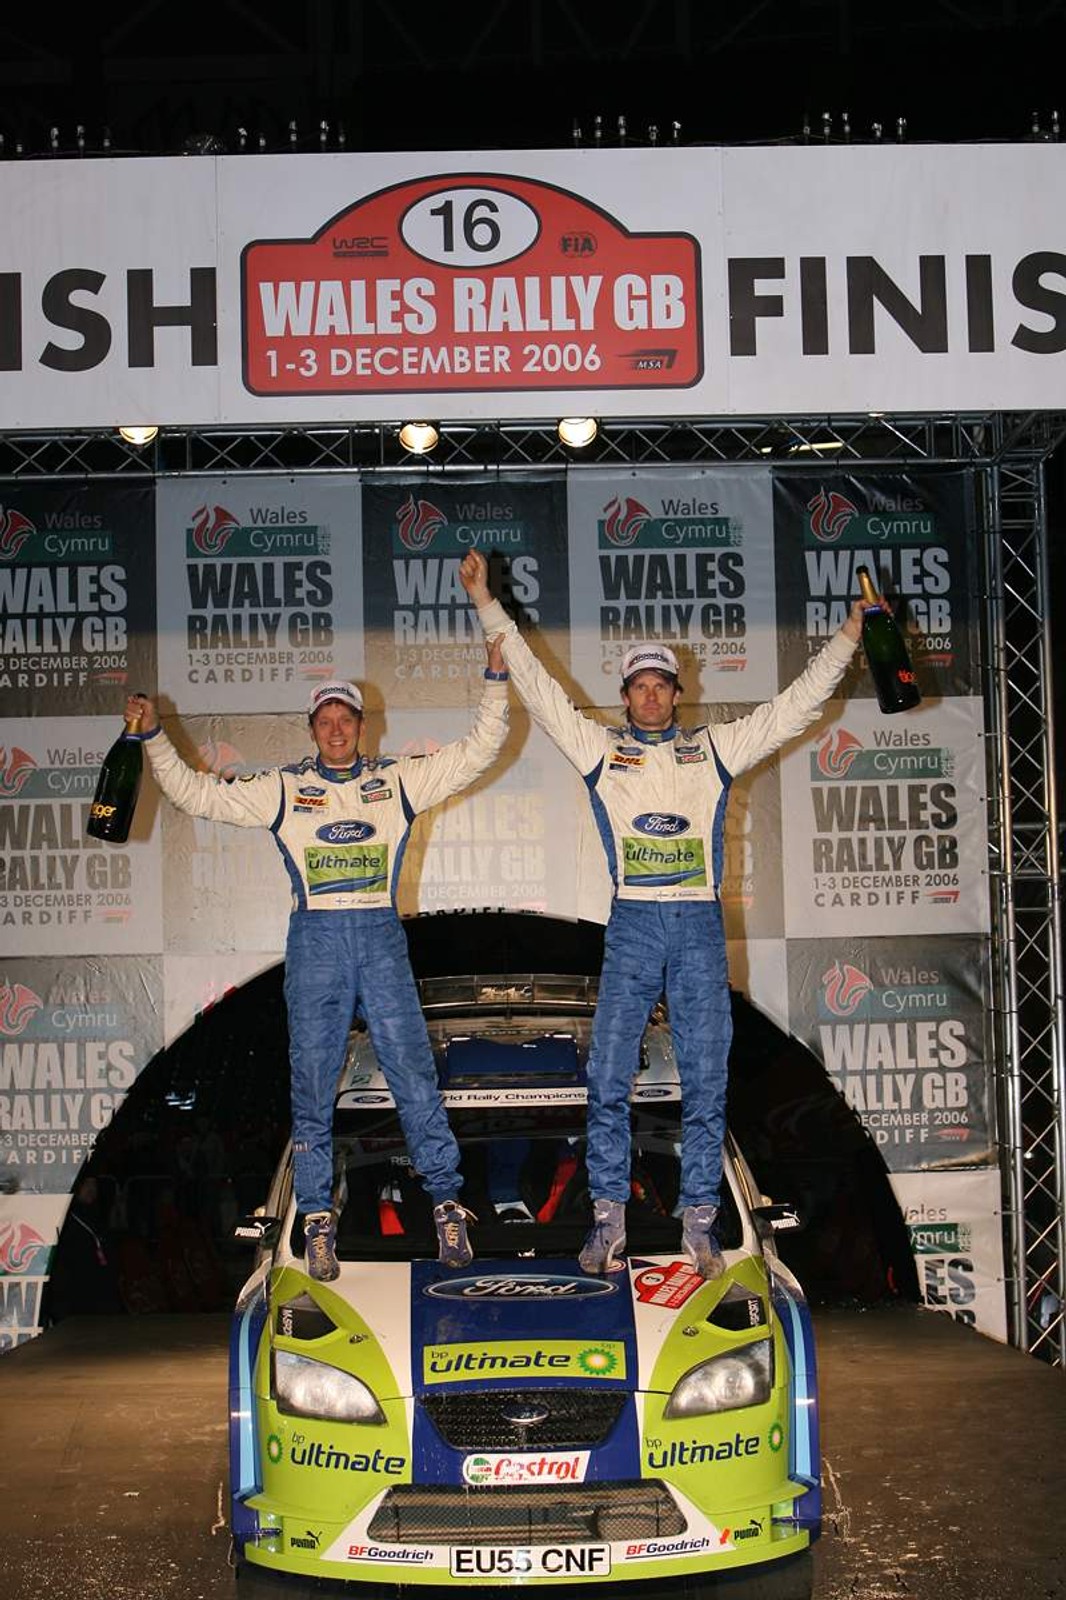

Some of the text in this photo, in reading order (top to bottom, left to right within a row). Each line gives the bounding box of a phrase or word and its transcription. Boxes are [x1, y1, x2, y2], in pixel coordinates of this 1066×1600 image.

[430, 199, 501, 253] 16
[332, 237, 389, 251] WRC
[561, 235, 593, 253] FIA
[258, 273, 685, 338] WALES RALLY GB
[266, 343, 602, 377] 1-3 DECEMBER 2006
[456, 502, 513, 520] Wales
[661, 498, 719, 517] Wales
[866, 496, 924, 513] Wales
[44, 511, 102, 530] Wales
[250, 506, 308, 524] Wales
[456, 526, 521, 548] Cymru
[661, 521, 726, 544] Cymru
[867, 517, 932, 539] Cymru
[44, 534, 109, 554] Cymru
[250, 529, 315, 552] Cymru
[598, 551, 745, 600] WALES
[805, 547, 951, 596] WALES
[186, 560, 334, 609] WALES
[599, 603, 747, 641] RALLY GB
[908, 598, 952, 634] GB
[0, 615, 128, 654] ALLY GB
[187, 611, 335, 650] RALLY GB
[712, 642, 747, 655] 2006
[918, 637, 952, 650] 2006
[10, 656, 89, 671] DECEMBER
[93, 655, 128, 668] 2006
[188, 651, 334, 665] 1-3 DECEMBER 2006
[188, 667, 295, 684] CARDIFF
[873, 729, 931, 747] Wales
[47, 747, 104, 766] Wales
[873, 752, 938, 775] Cymru
[810, 782, 959, 833] WALES
[328, 823, 364, 840] Ford
[644, 815, 679, 832] Ford
[308, 854, 381, 870] ultimate
[625, 847, 695, 864] ultimate
[812, 833, 959, 873] RALLY GB
[85, 853, 132, 890] GB
[813, 873, 959, 889] 1-3 DECEMBER 2006
[15, 894, 92, 908] DECEMBER
[97, 892, 131, 906] 2006
[427, 883, 545, 899] DECEMBER 2006
[813, 890, 920, 907] CARDIFF
[880, 965, 939, 985] Wales
[881, 990, 947, 1012] Cymru
[52, 1010, 117, 1033] Cymru
[819, 1019, 969, 1071] WALES
[442, 1091, 586, 1103] rld Rally Champions
[922, 1071, 968, 1110] GB
[933, 1111, 968, 1124] 2006
[18, 1133, 97, 1147] DECEMBER
[462, 1277, 578, 1296] Ford
[430, 1351, 572, 1374] ultimate
[431, 1350, 449, 1360] bp
[291, 1432, 306, 1446] bp
[646, 1437, 662, 1450] bp
[290, 1442, 407, 1475] ultimate
[647, 1433, 760, 1470] ultimate
[494, 1456, 580, 1481] Castrol
[348, 1545, 434, 1561] BFGoodrich
[626, 1536, 710, 1556] BFGoodrich
[455, 1547, 605, 1573] EU55 CNF
